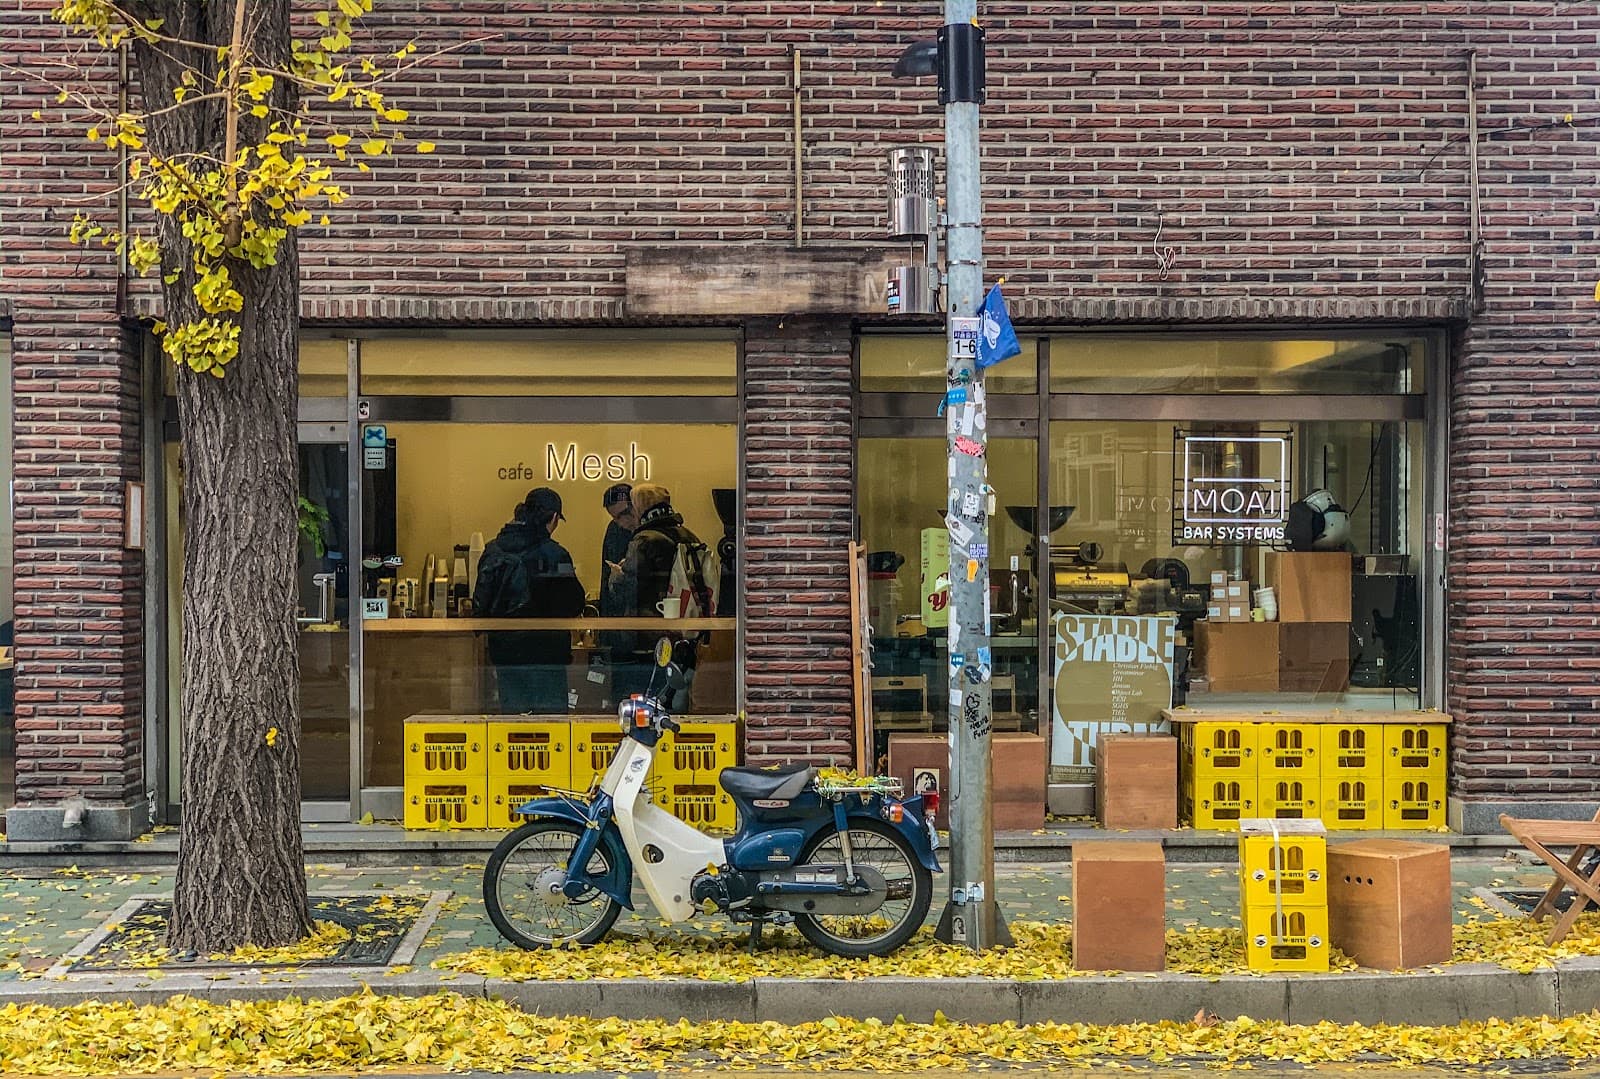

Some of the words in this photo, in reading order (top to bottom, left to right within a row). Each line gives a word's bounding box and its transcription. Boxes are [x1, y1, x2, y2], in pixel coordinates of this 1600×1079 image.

[955, 340, 976, 354] 1-6
[498, 463, 533, 480] cafe
[546, 442, 651, 481] Mesh
[1193, 488, 1275, 515] MOAI
[1184, 526, 1212, 539] BAR
[1217, 526, 1285, 540] SYSTEMS
[1057, 616, 1173, 663] STABLE
